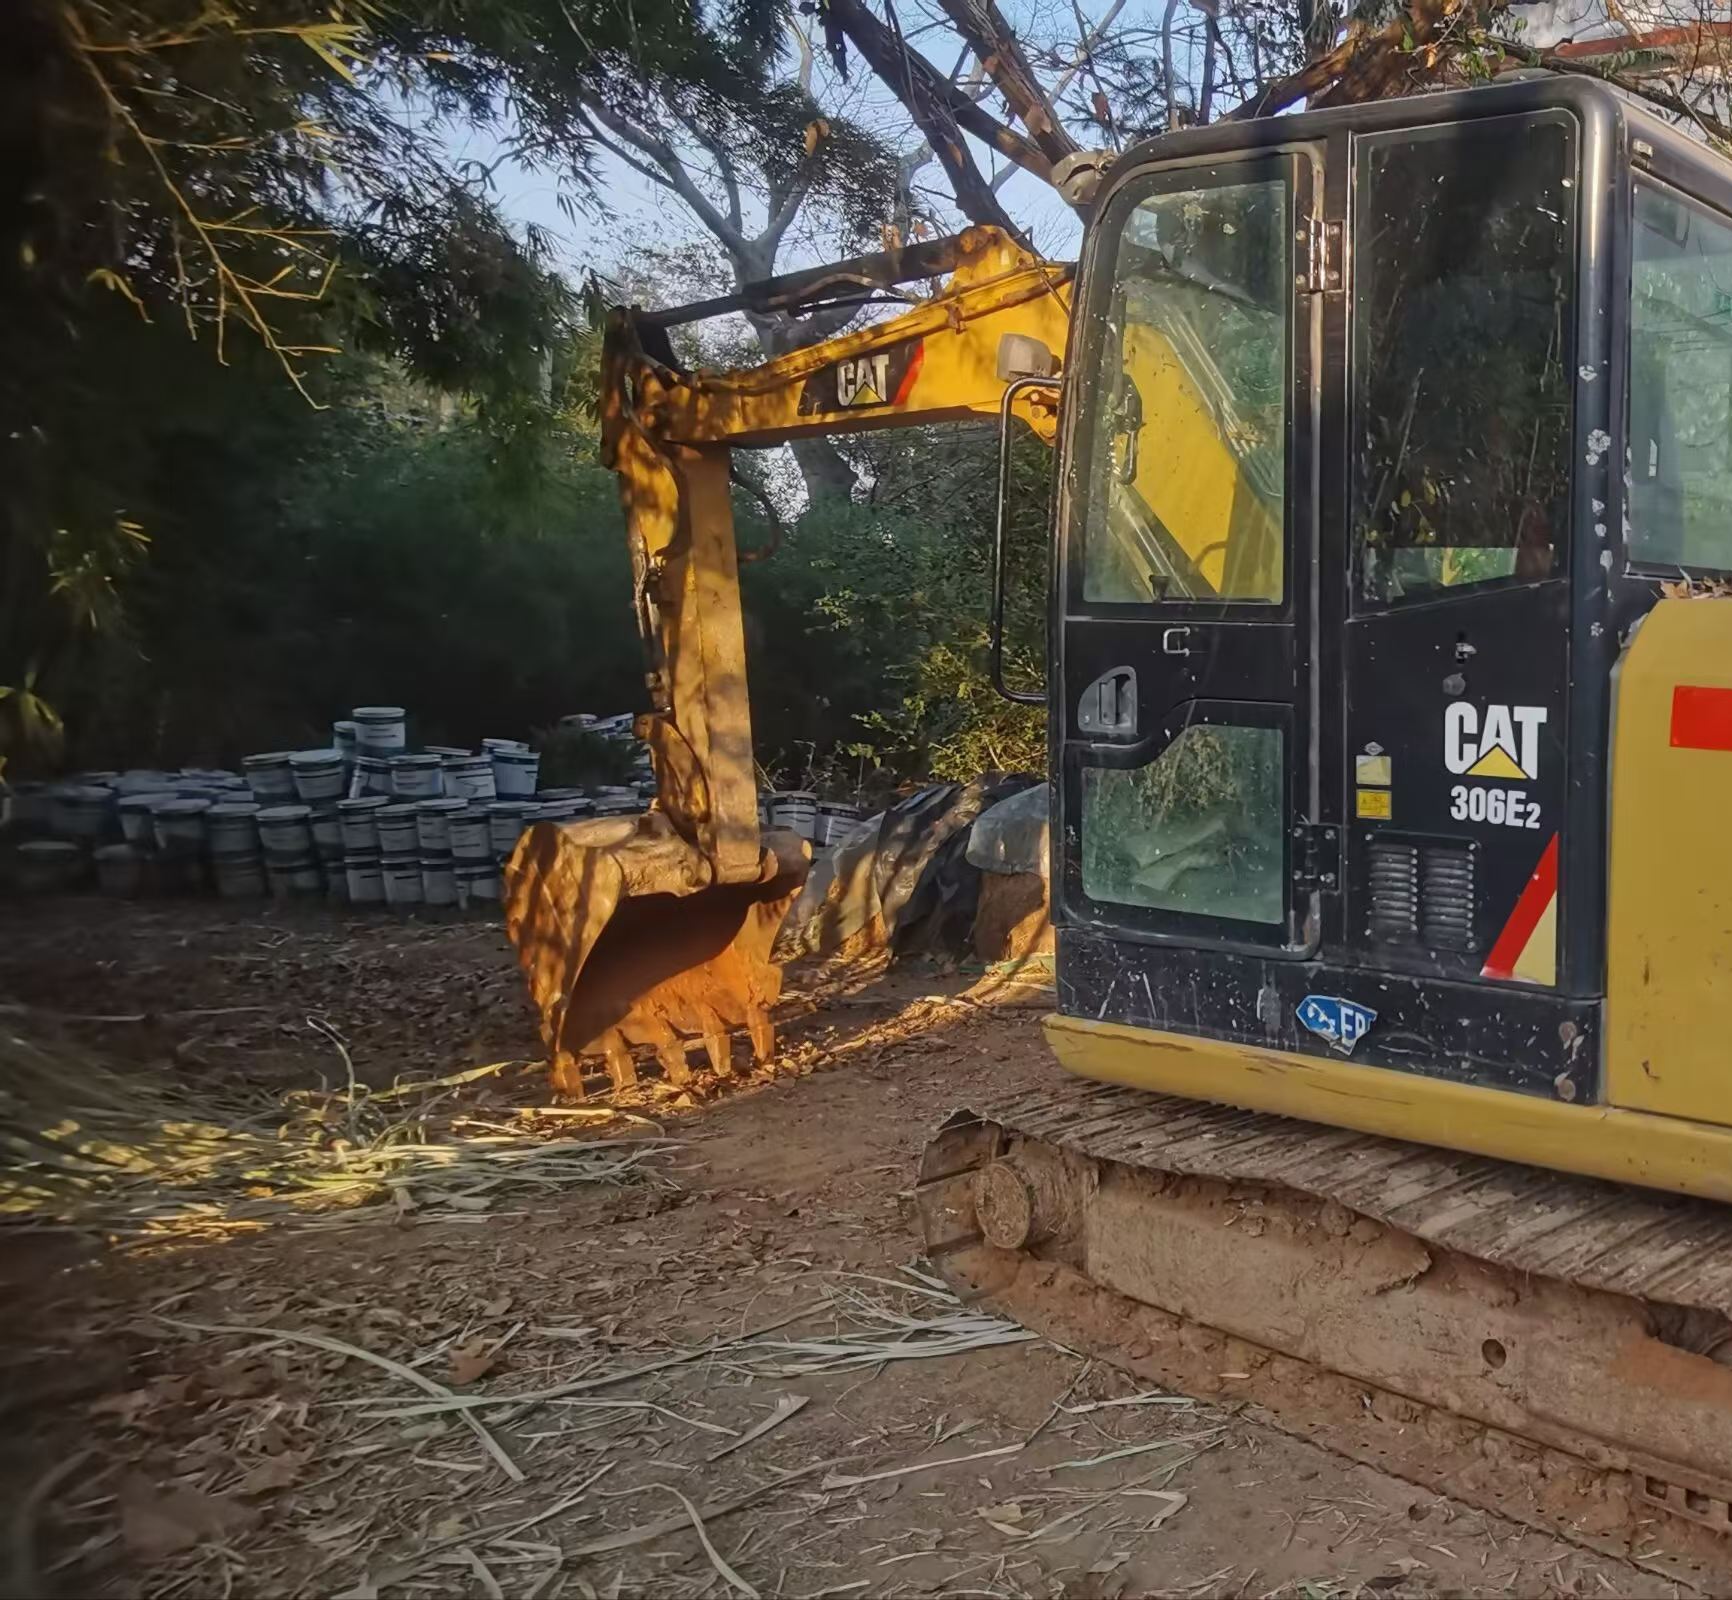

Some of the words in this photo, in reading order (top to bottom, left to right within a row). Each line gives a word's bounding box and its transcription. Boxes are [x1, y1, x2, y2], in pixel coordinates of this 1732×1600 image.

[837, 354, 889, 406] CAT
[1444, 702, 1547, 780] CAT
[1450, 785, 1541, 829] 306E2
